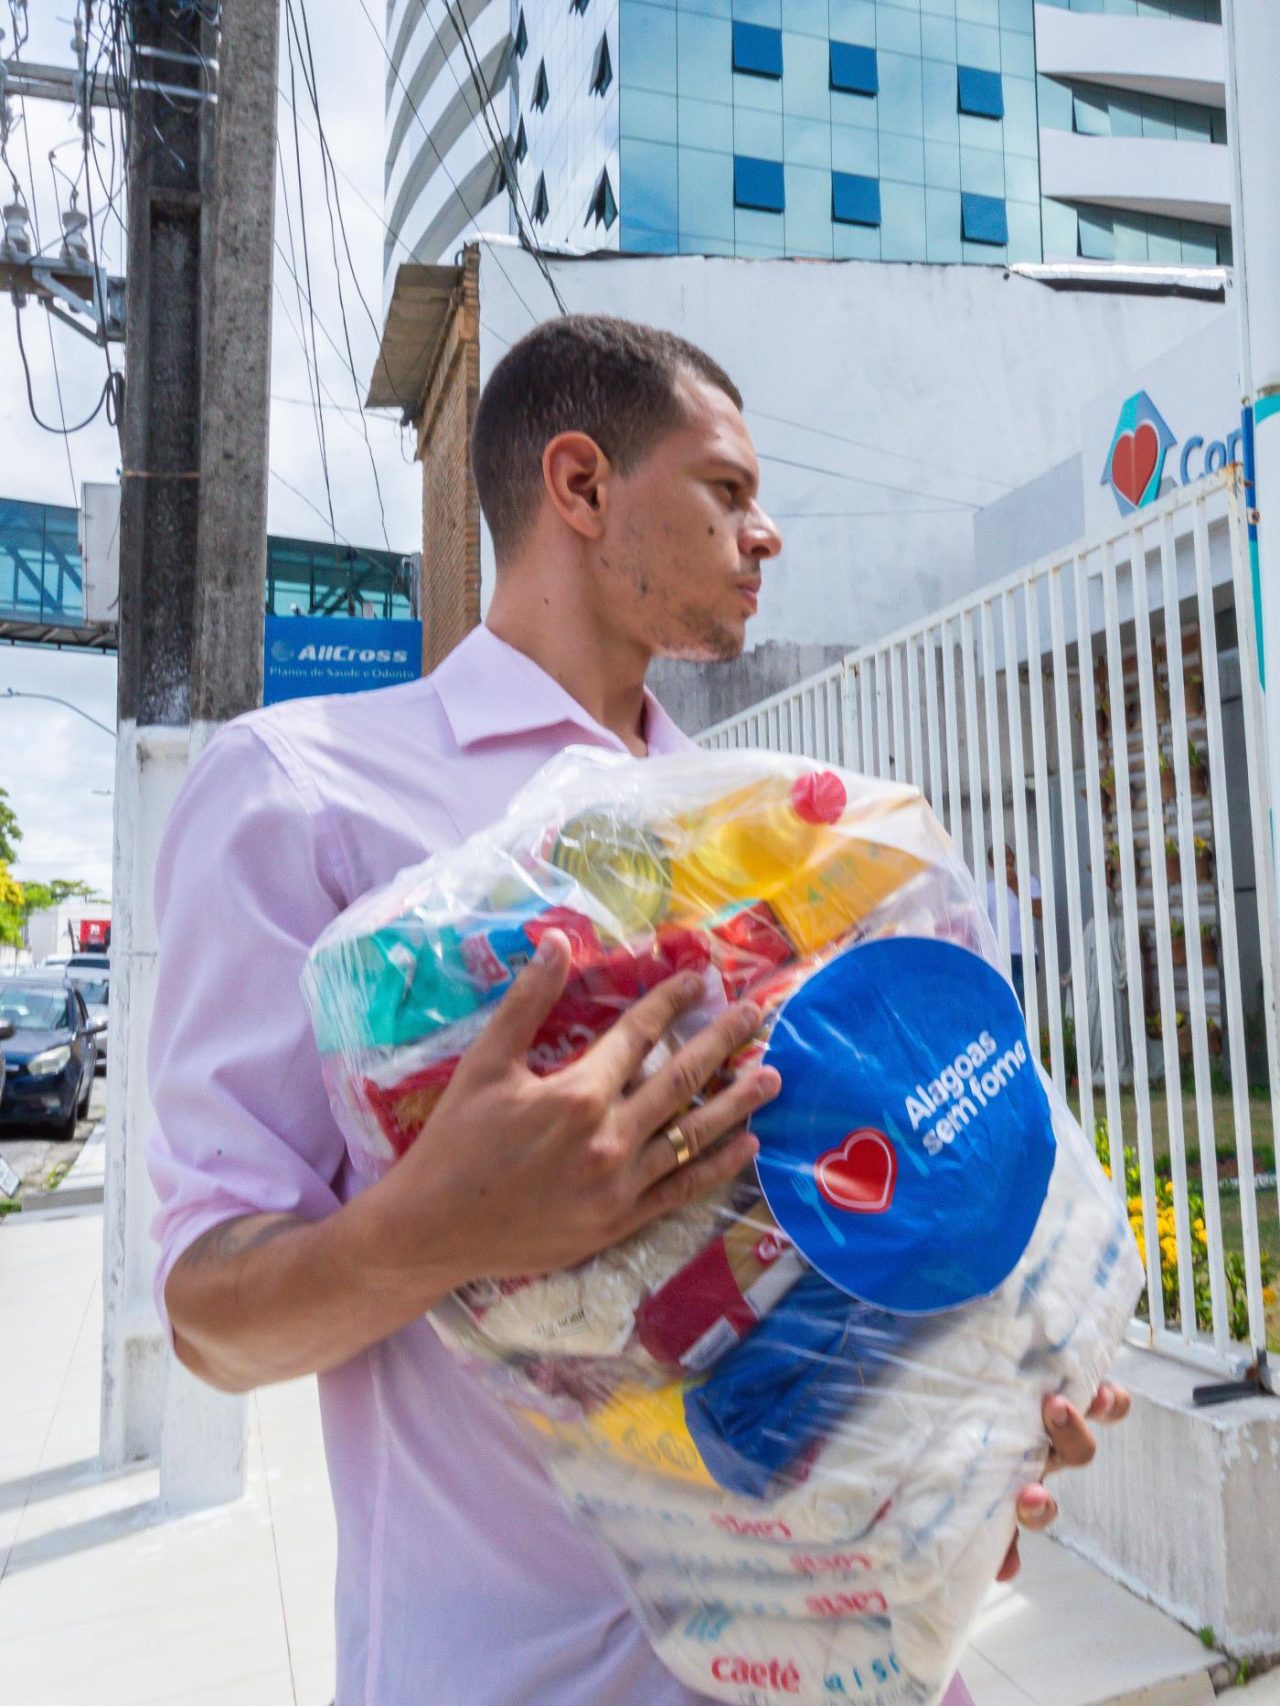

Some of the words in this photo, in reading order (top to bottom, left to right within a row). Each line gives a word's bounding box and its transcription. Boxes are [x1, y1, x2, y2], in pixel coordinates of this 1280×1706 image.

[298, 644, 408, 663] AllCross
[905, 1030, 997, 1131] Alagoas
[922, 1096, 979, 1156] sem
